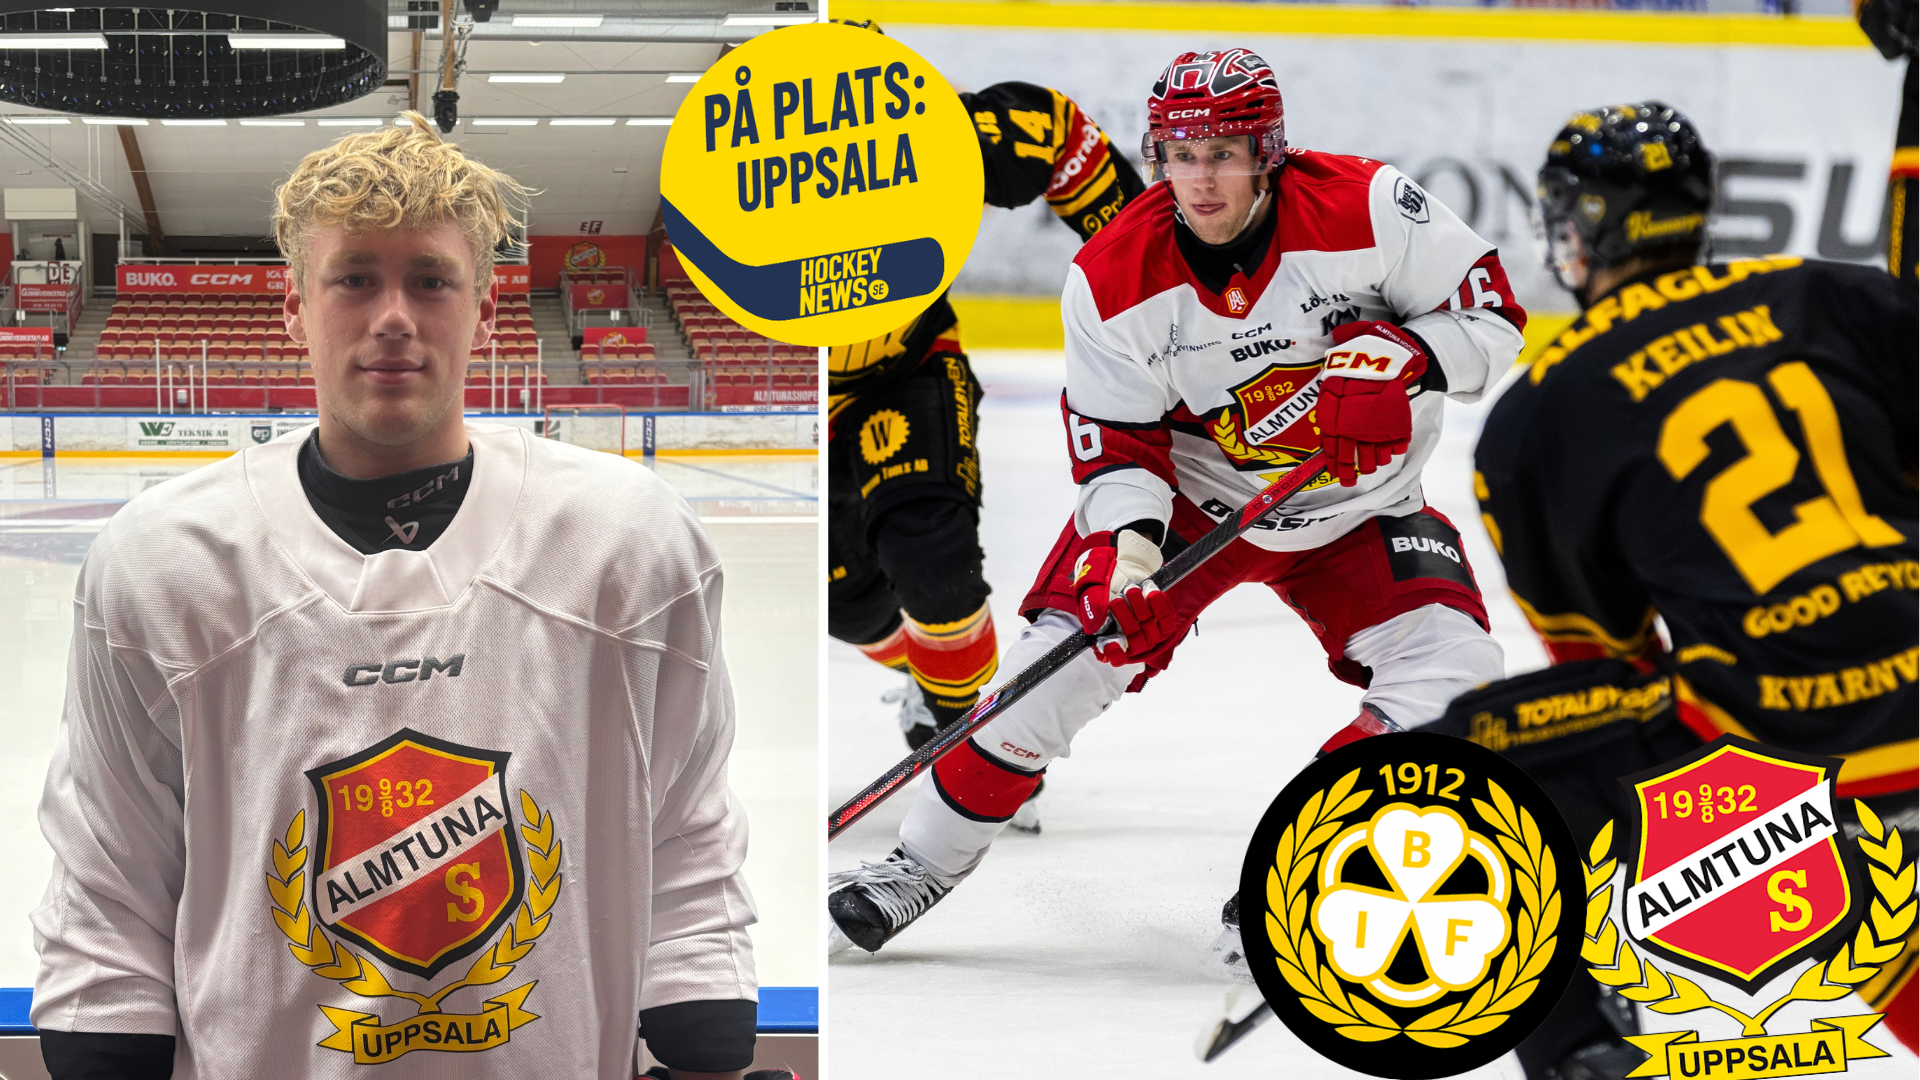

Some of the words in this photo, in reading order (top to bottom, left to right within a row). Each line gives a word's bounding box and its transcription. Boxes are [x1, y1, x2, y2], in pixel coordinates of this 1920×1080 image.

[1168, 108, 1211, 120] CCM
[1008, 109, 1054, 165] 14
[126, 272, 178, 286] BUKO.
[190, 273, 254, 285] CCM
[511, 275, 529, 284] AB
[1231, 322, 1272, 340] CCM
[1375, 324, 1401, 343] ALMTUNA
[1230, 338, 1297, 362] BUKO.
[1324, 351, 1393, 373] CM
[1610, 304, 1784, 402] KEILIN
[178, 429, 212, 437] TEKNIK
[217, 429, 228, 437] AB
[253, 429, 270, 441] ep
[870, 418, 892, 451] W
[1069, 413, 1103, 462] 6
[387, 465, 459, 510] CCM
[1655, 360, 1907, 596] 21
[1391, 536, 1464, 568] BUKO.
[1083, 595, 1094, 620] CCM
[1742, 583, 1842, 639] GOOD
[343, 653, 466, 687] CCM
[1000, 741, 1041, 760] CCM
[326, 795, 504, 914] ALMTUNA
[362, 1018, 502, 1059] UPPSALA
